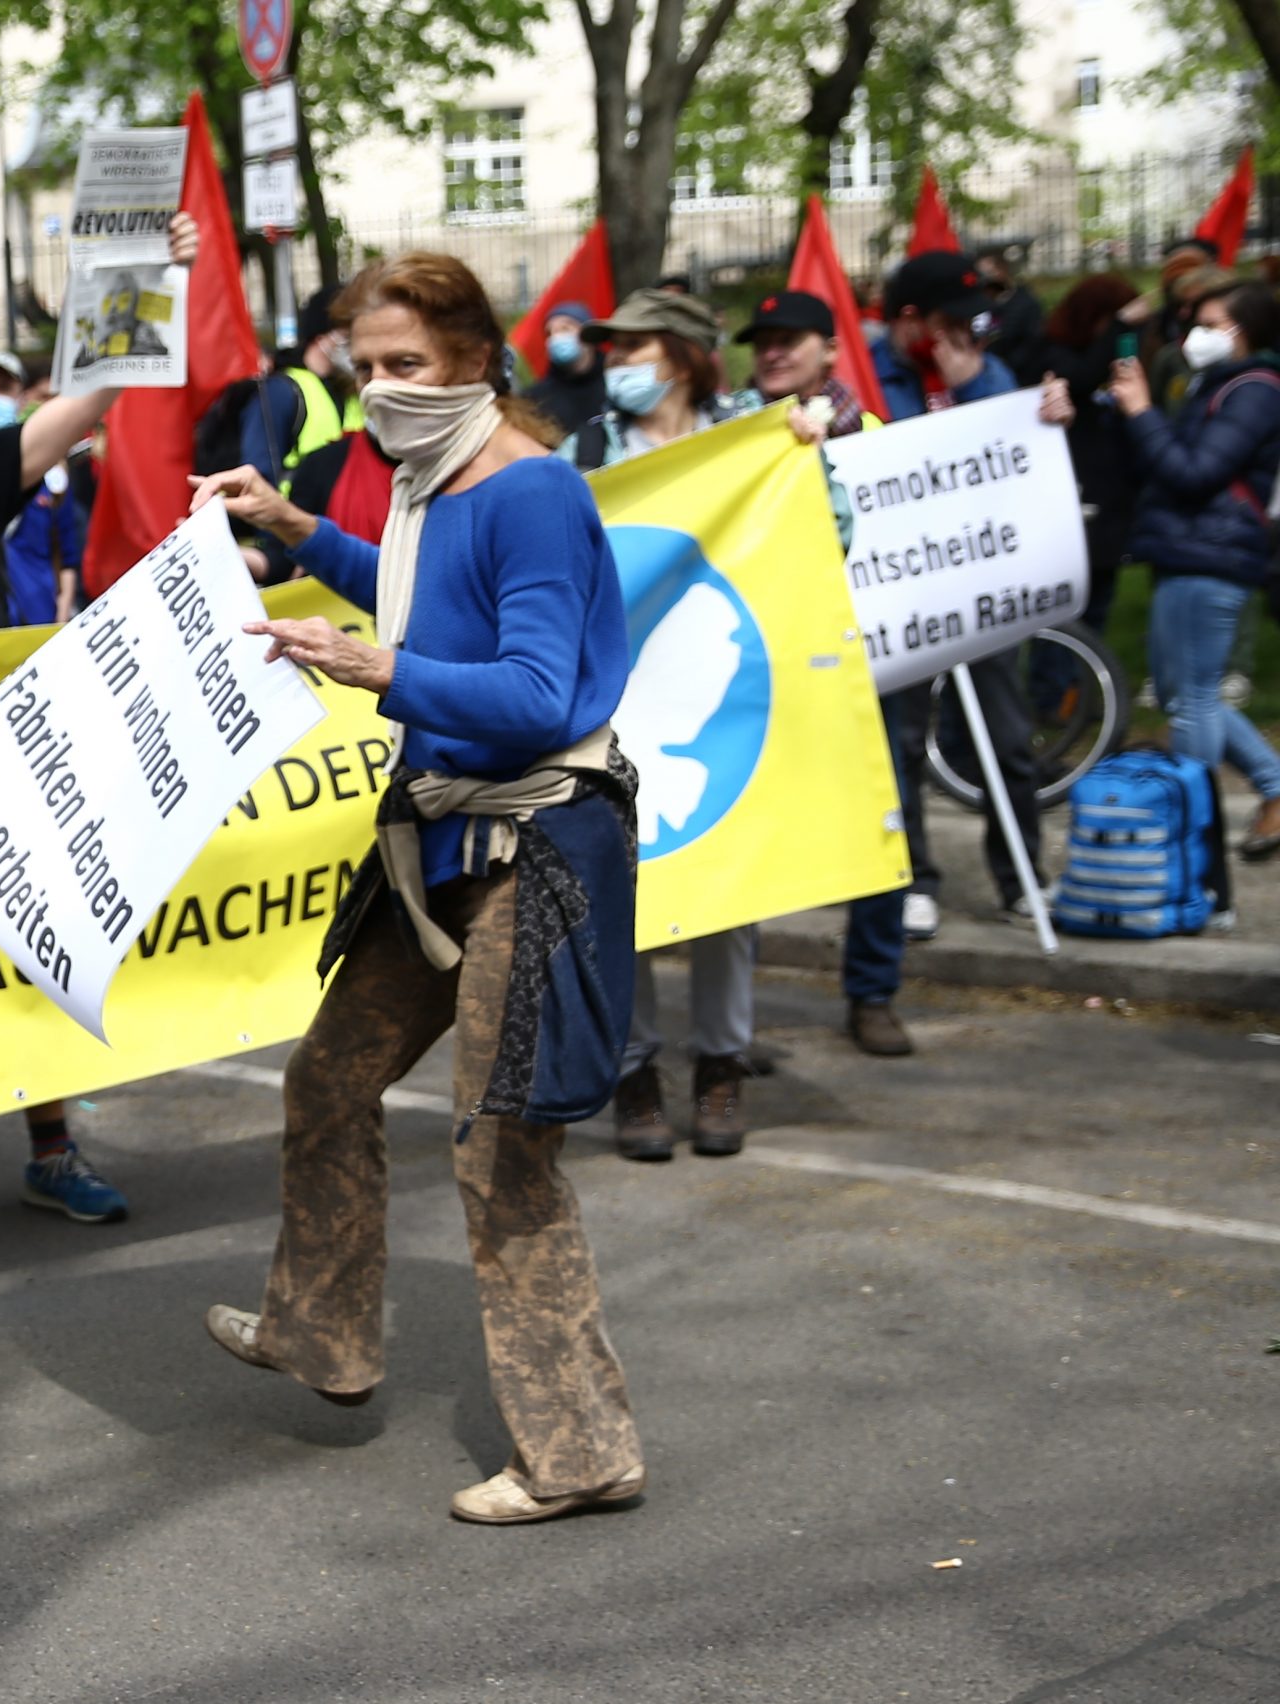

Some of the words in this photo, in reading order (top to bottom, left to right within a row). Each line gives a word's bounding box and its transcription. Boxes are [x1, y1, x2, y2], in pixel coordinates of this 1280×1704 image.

[855, 440, 1031, 513] emokratie
[851, 518, 1019, 590] ntscheide
[151, 539, 217, 656] Häuser
[195, 637, 262, 756] denen
[904, 611, 964, 651] den
[976, 580, 1075, 632] Räten
[86, 615, 141, 698] drin
[123, 684, 189, 820] wohnen
[0, 666, 87, 830] Fabriken
[67, 816, 133, 945] denen
[272, 737, 392, 812] DER
